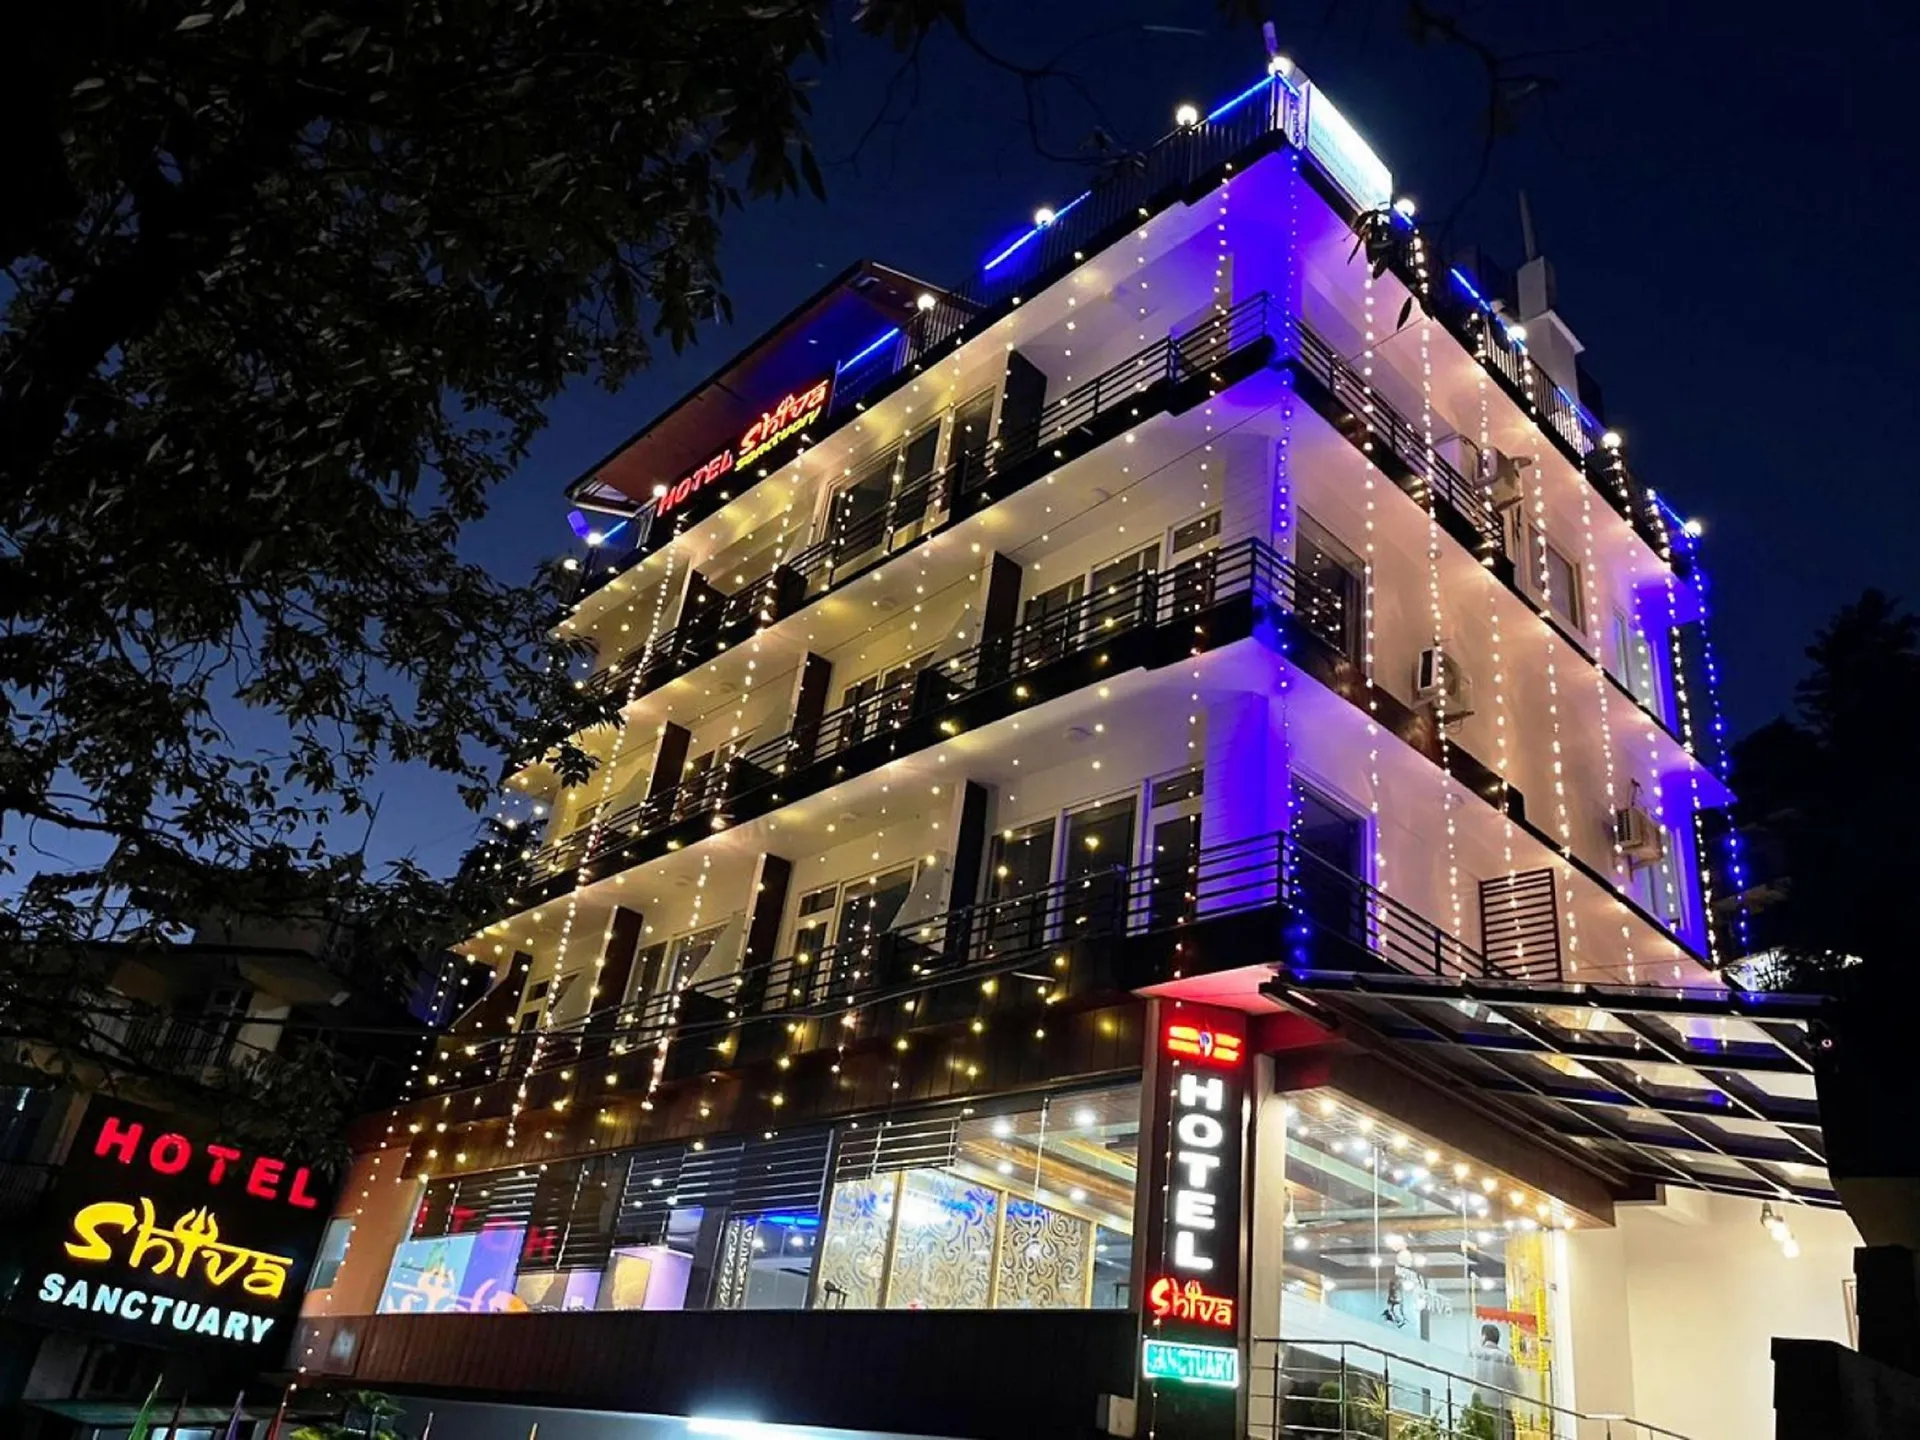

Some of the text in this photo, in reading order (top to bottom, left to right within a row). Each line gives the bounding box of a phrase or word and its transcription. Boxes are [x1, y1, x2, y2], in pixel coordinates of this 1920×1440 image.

[656, 378, 830, 517] HOTEL Shiva
[94, 1116, 319, 1209] HOTEL
[1174, 1073, 1224, 1271] HOTEL
[64, 1196, 294, 1300] Shiva
[38, 1272, 275, 1345] SANCTUARY
[1149, 1277, 1233, 1327] Shiva
[1147, 1344, 1235, 1382] SANCTUARY
